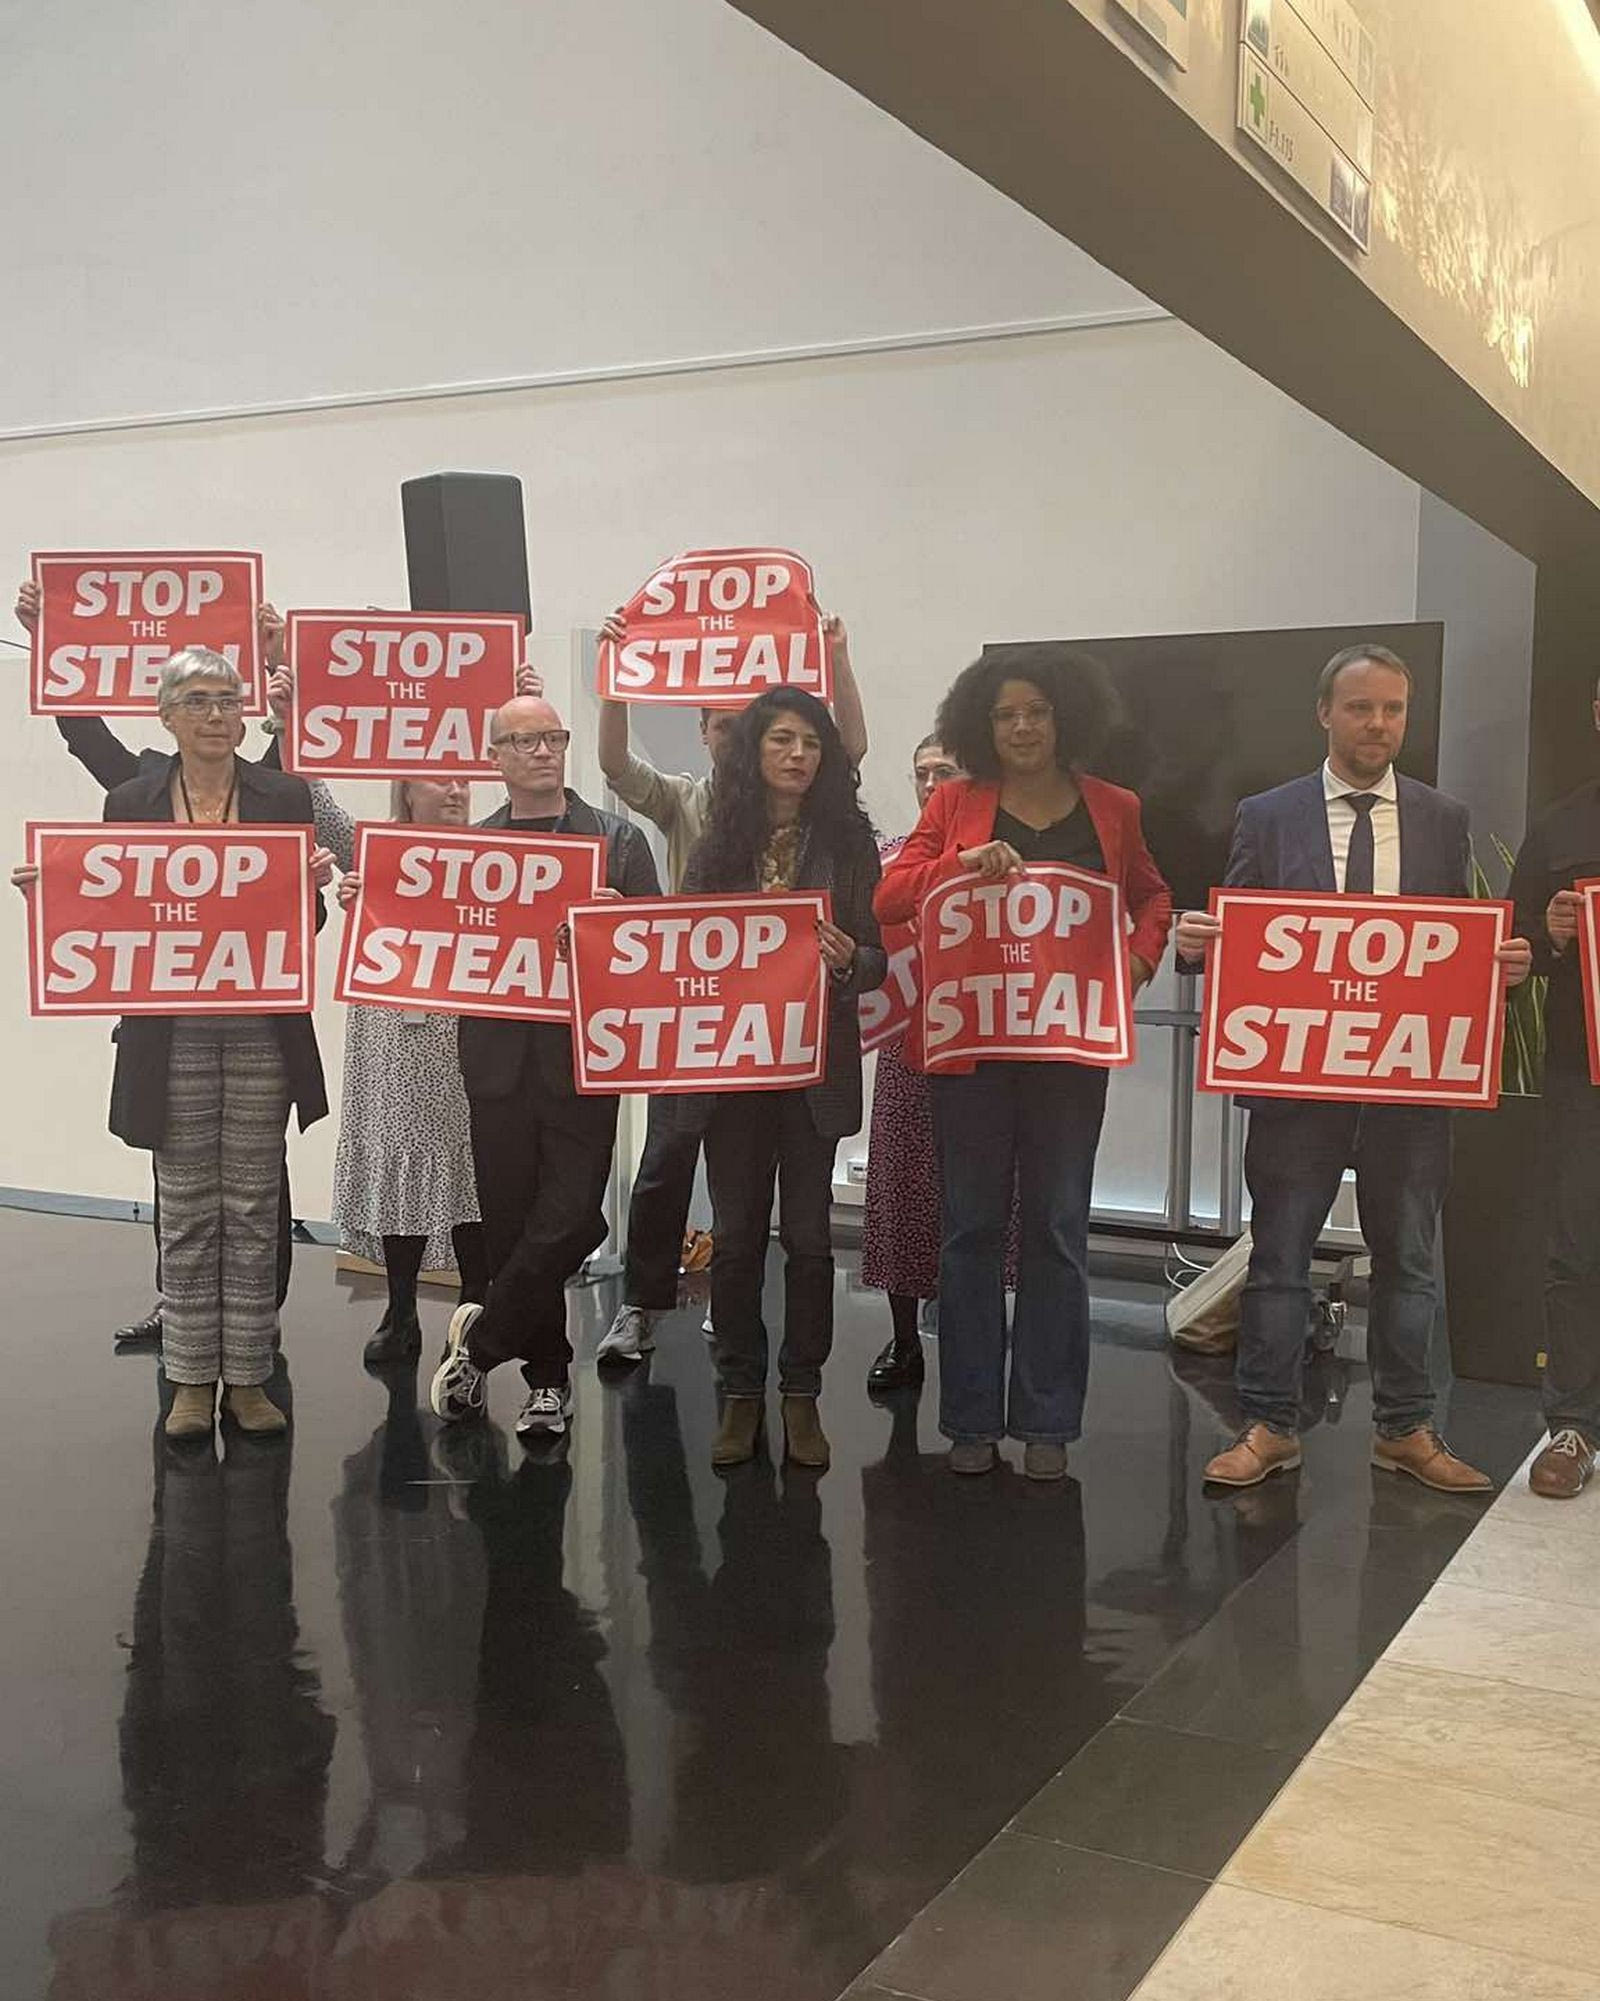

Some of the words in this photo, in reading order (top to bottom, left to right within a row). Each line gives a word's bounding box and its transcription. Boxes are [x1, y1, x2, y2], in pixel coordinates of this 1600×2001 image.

[72, 569, 224, 617] STOP
[642, 564, 791, 616] STOP
[129, 620, 167, 638] THE
[697, 614, 735, 631] THE
[44, 643, 252, 698] STE
[327, 628, 486, 678] STOP
[616, 632, 820, 688] STEAL
[386, 681, 426, 700] THE
[79, 843, 268, 898] STOP
[395, 845, 563, 905] STOP
[151, 902, 197, 923] THE
[454, 904, 498, 928] THE
[938, 880, 1092, 950] STOP
[45, 930, 300, 993] STEAL
[609, 914, 787, 975] STOP
[1000, 943, 1031, 963] THE
[1258, 914, 1459, 977] STOP
[675, 976, 720, 997] THE
[926, 971, 1118, 1045] STEAL
[1330, 979, 1378, 1003] THE
[585, 1001, 815, 1072] STEAL
[1215, 1005, 1481, 1081] STEAL
